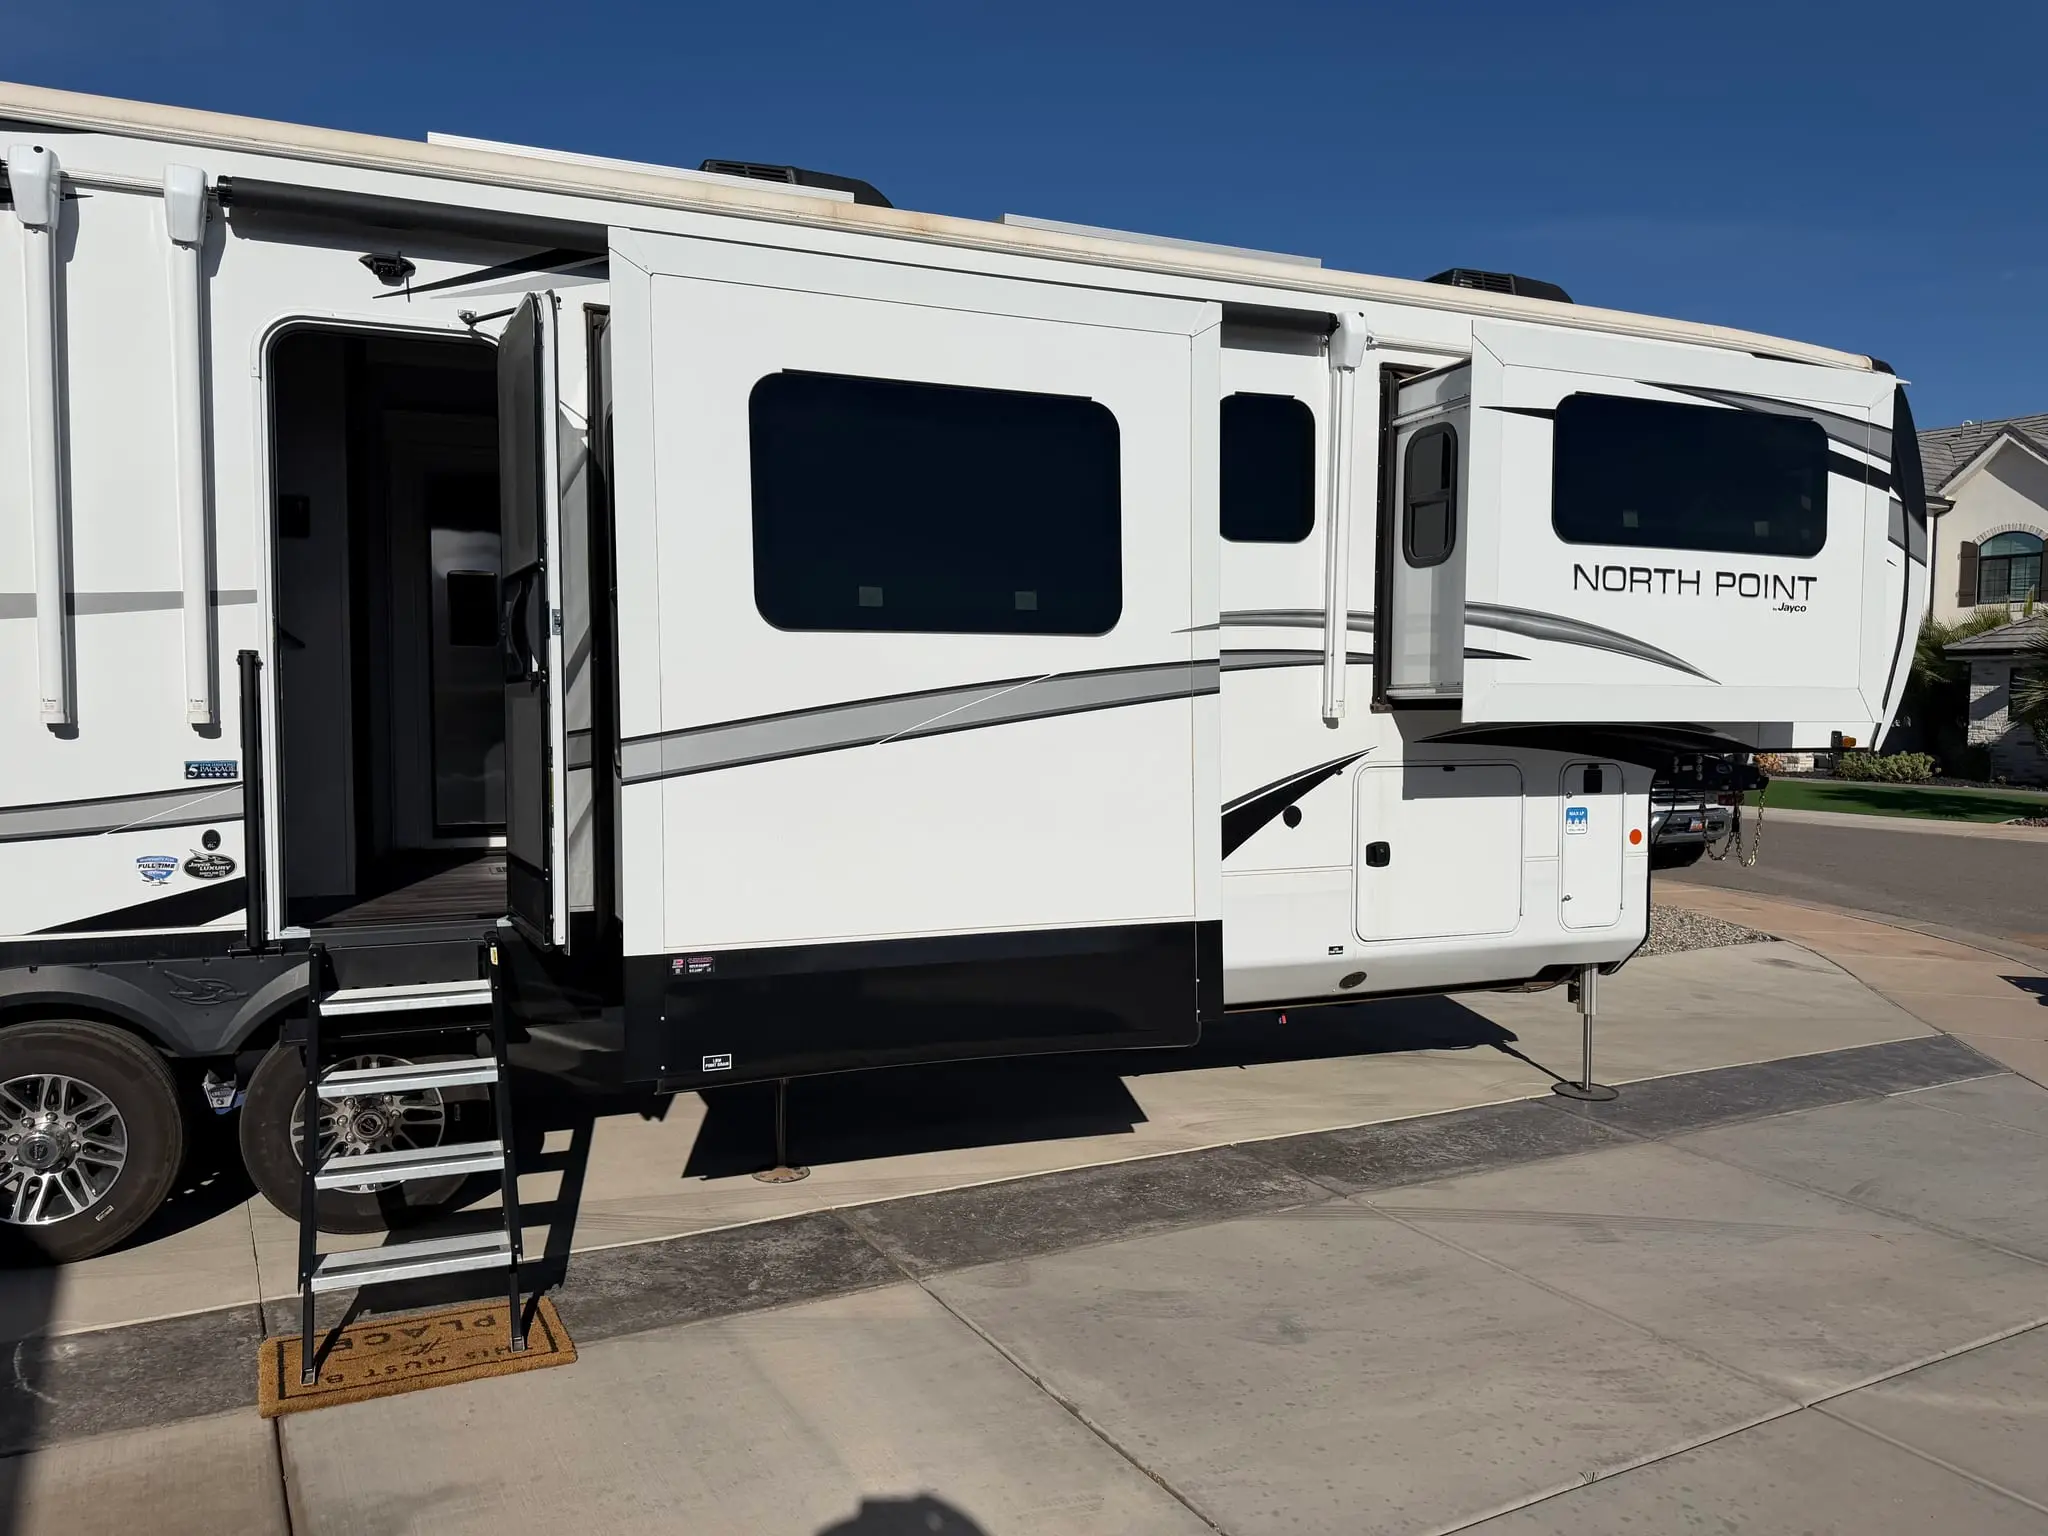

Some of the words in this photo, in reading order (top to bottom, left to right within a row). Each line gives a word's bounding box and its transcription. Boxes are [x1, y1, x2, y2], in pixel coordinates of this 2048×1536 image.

[1573, 563, 1701, 596] NORTH
[1715, 571, 1818, 601] POINT
[1777, 602, 1807, 614] Jayco
[137, 862, 156, 870] FULL
[157, 862, 176, 870] TIME
[199, 864, 232, 872] LUXURY
[362, 1356, 447, 1379] MUST
